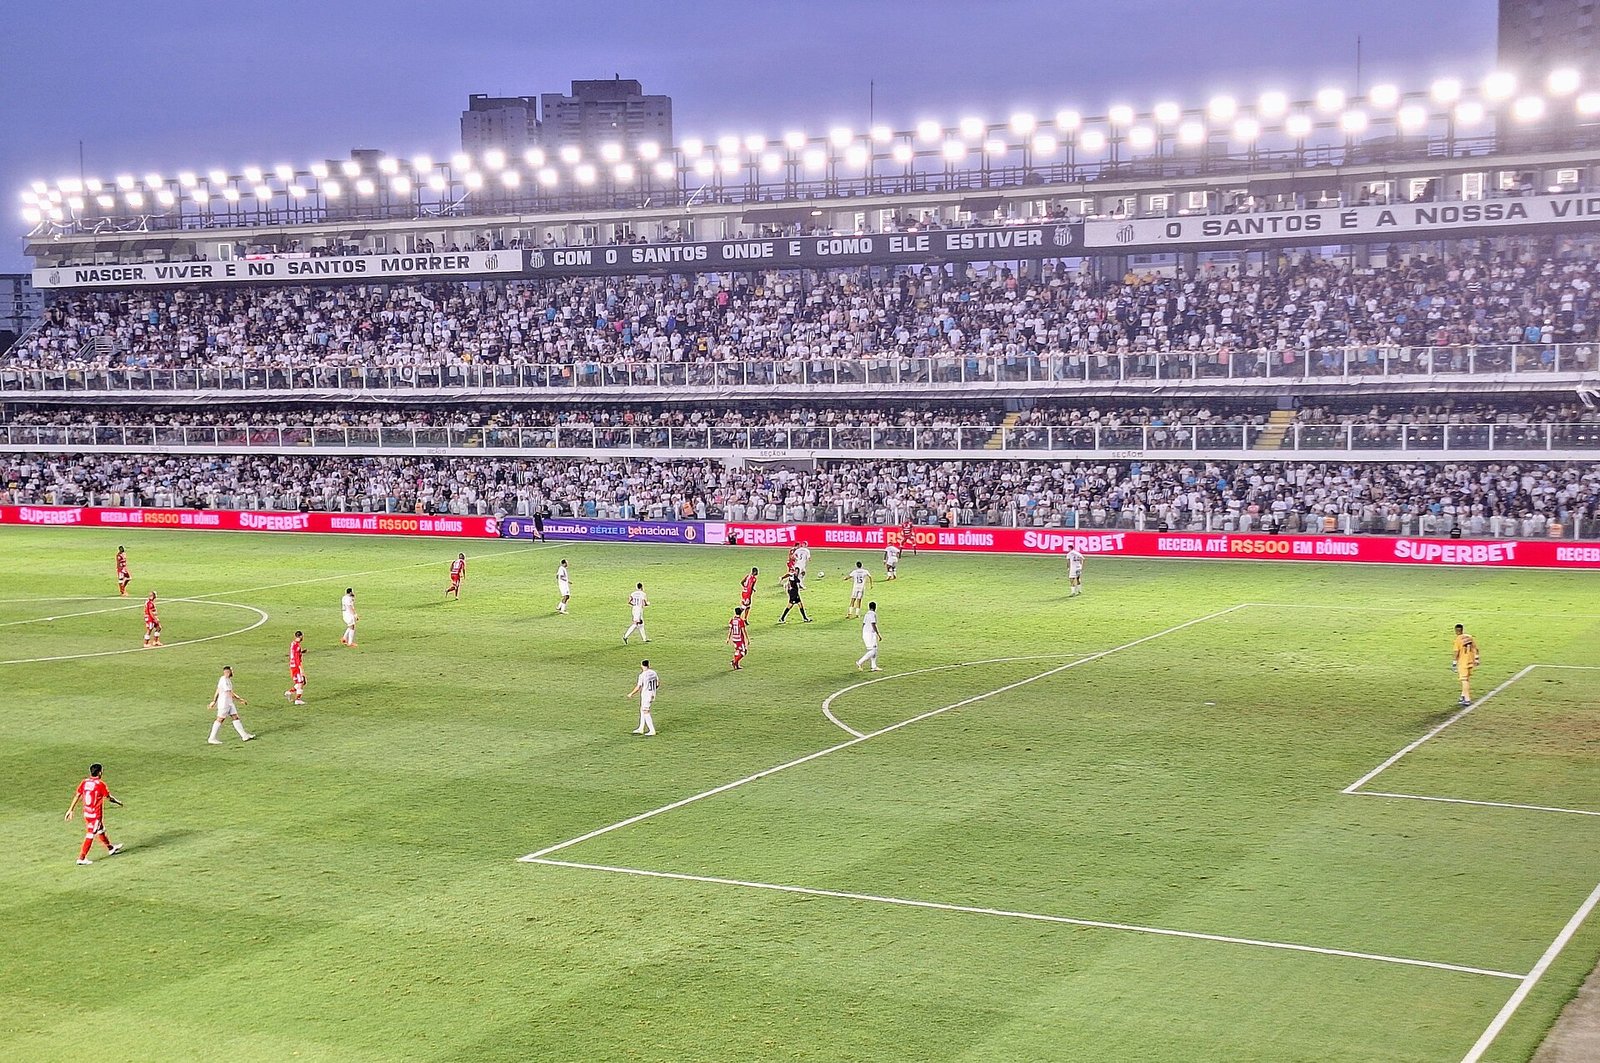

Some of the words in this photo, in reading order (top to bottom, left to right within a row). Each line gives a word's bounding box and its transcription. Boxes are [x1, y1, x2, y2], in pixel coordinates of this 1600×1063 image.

[1165, 222, 1181, 238] O
[1202, 214, 1321, 237] SANTOS
[1340, 208, 1357, 228] É
[1375, 210, 1398, 227] A
[1415, 202, 1528, 224] NOSSA
[553, 250, 592, 266] COM
[605, 249, 617, 264] O
[632, 245, 707, 264] SANTOS
[722, 242, 774, 260] ONDE
[789, 241, 801, 256] E
[816, 238, 873, 256] COMO
[889, 235, 930, 253] ELE
[946, 230, 1042, 250] ESTIVER
[154, 265, 213, 279] VIVER
[226, 264, 236, 277] E
[249, 263, 275, 276] NO
[287, 259, 367, 275] SANTOS
[380, 255, 470, 272] MORRER
[20, 507, 82, 525] SUPERBET
[144, 512, 179, 524] R$500
[240, 512, 309, 530] SUPERBET
[331, 517, 361, 529] RECEBA
[362, 516, 380, 530] ATÉ
[379, 519, 418, 531] R$500
[419, 520, 433, 531] EM
[434, 518, 464, 532] BÔNUS
[524, 524, 588, 534] BRSILEIRÃO
[590, 524, 618, 535] SÉRIE
[619, 526, 626, 535] B
[628, 525, 679, 537] betnacional
[825, 530, 862, 543] RECEBA
[865, 528, 884, 543] ATÉ
[938, 532, 955, 546] EM
[957, 531, 994, 547] BÔNUS
[1023, 530, 1126, 552] SUPERBET
[1158, 537, 1203, 551] RECEBA
[1205, 535, 1228, 552] ATÉ
[1230, 539, 1290, 554] R$500
[1293, 541, 1313, 554] EM
[1315, 538, 1360, 556] BÔNUS
[1394, 540, 1517, 563] SUPERBET
